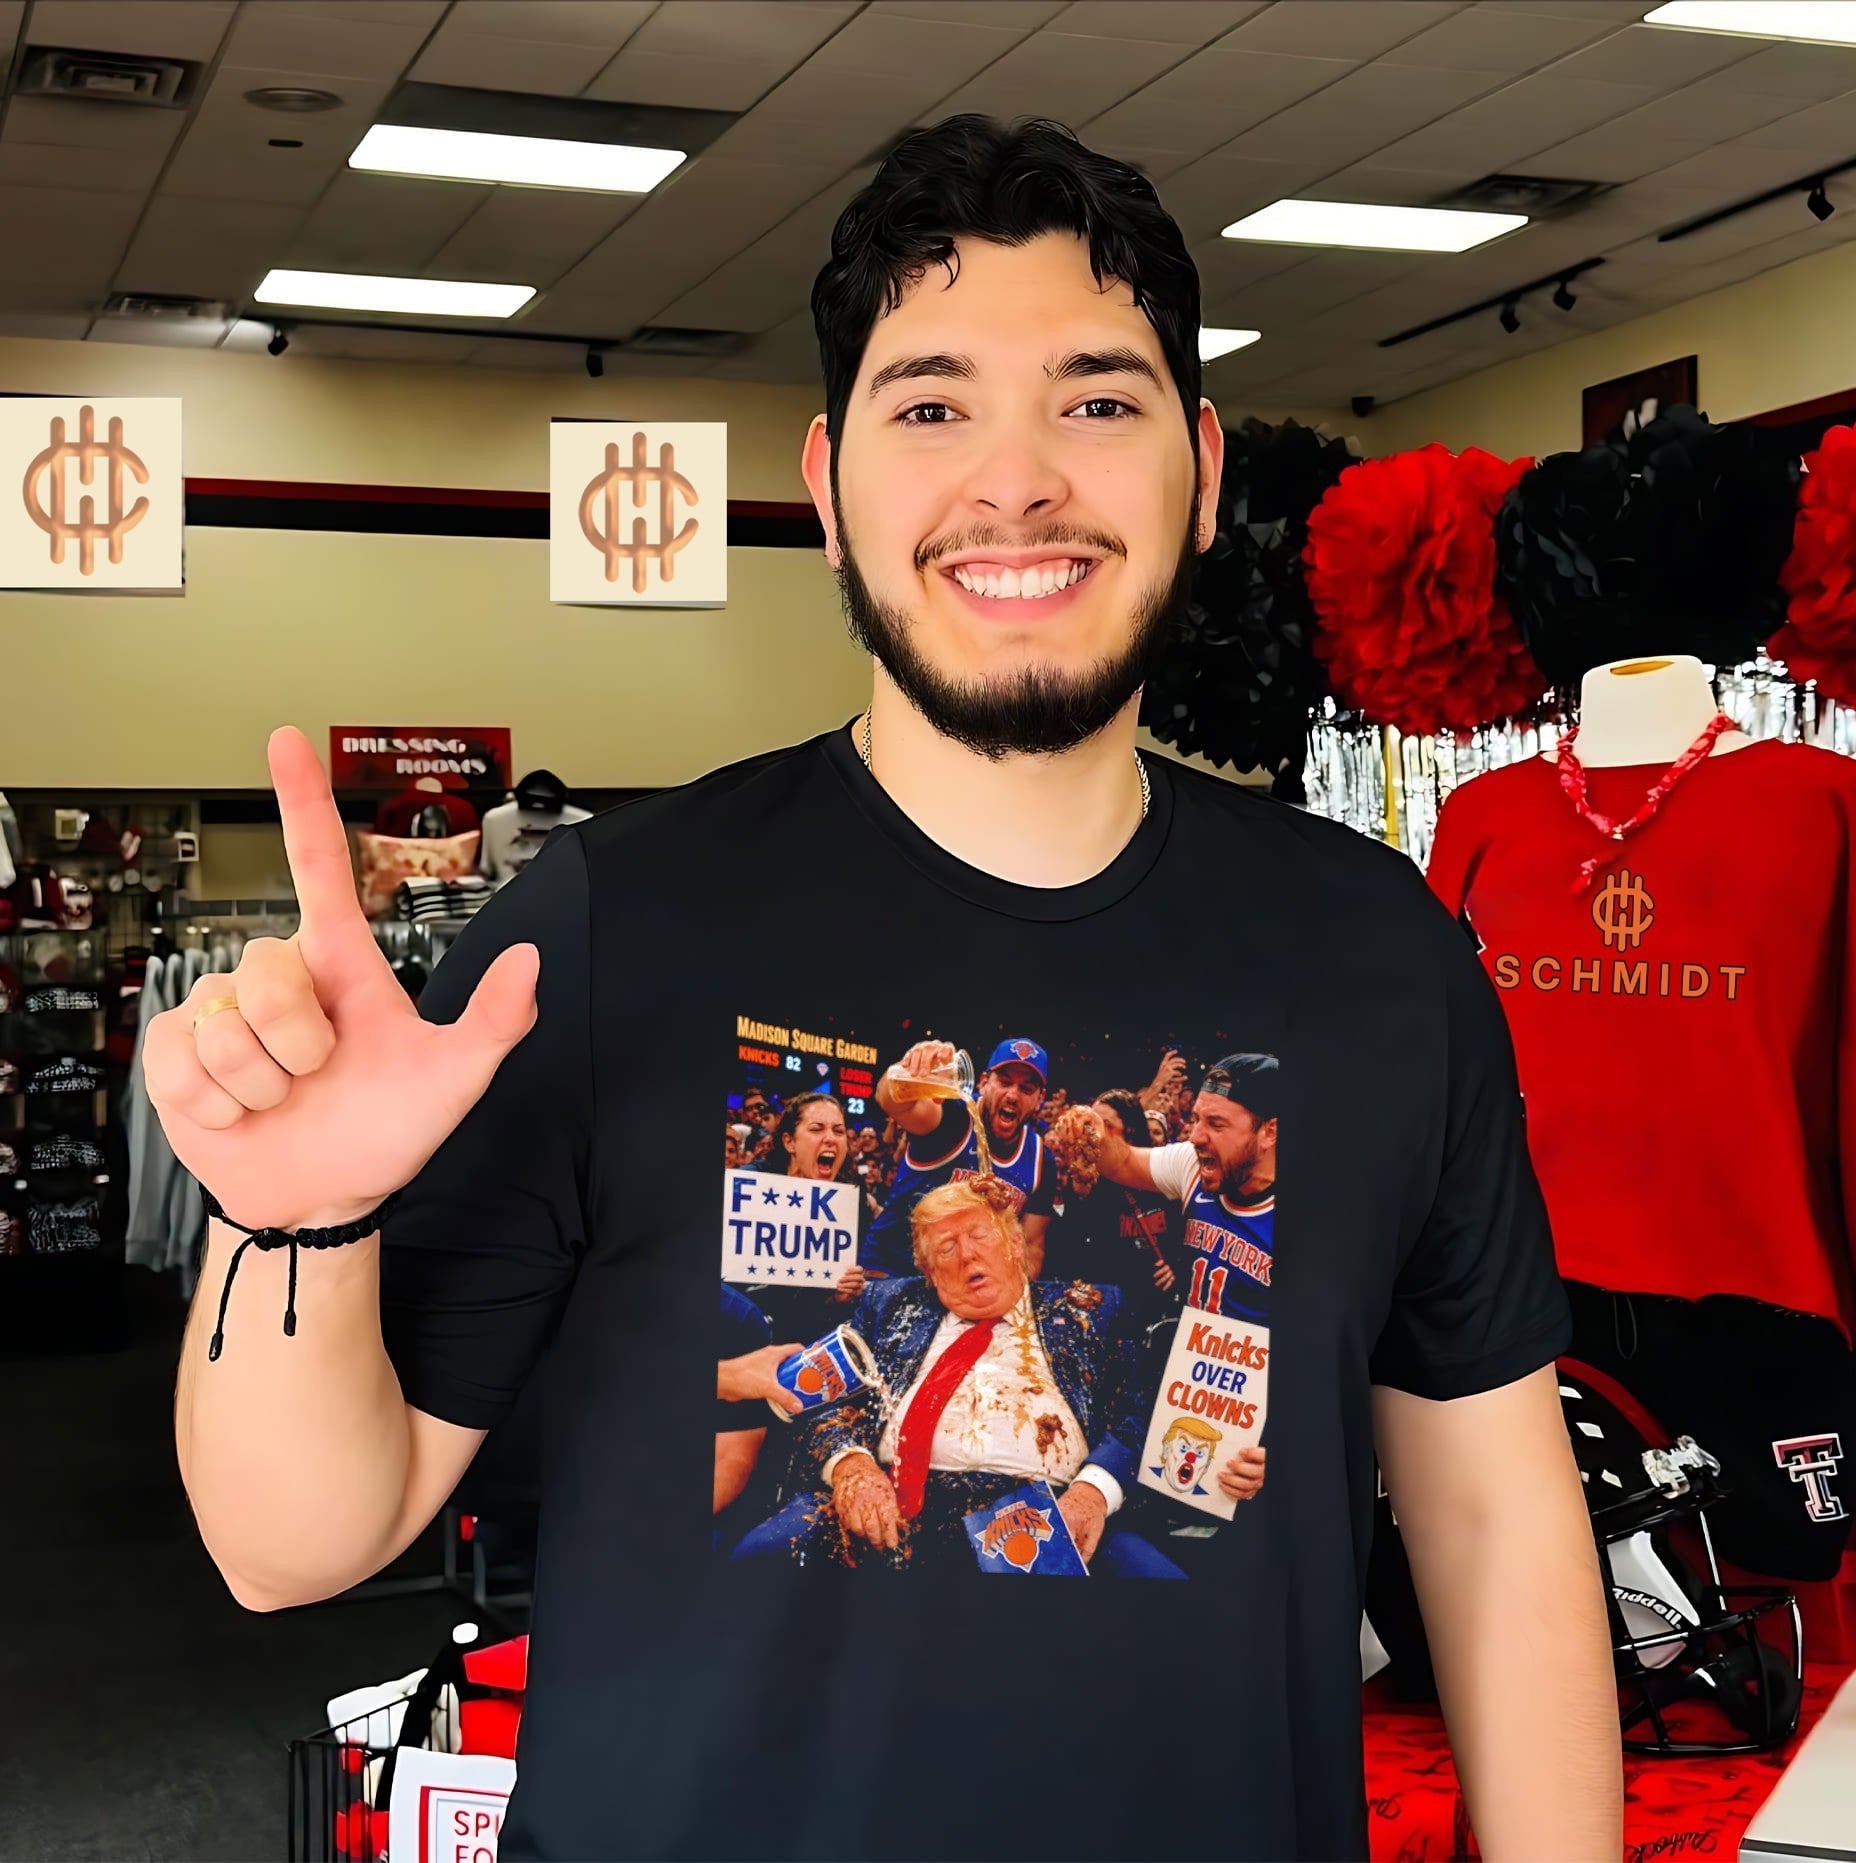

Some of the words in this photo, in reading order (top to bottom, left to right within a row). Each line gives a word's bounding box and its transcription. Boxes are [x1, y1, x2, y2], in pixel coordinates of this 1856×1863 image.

[1494, 953, 1746, 1001] SCHMIDT
[738, 1045, 781, 1068] KNICKS
[785, 1055, 802, 1073] 82
[847, 1098, 865, 1115] 23
[729, 1219, 852, 1263] TRUMP
[1184, 1218, 1220, 1254] NEW
[1218, 1229, 1273, 1287] YORK
[1187, 1257, 1230, 1315] 11
[1186, 1322, 1270, 1371] Knicks
[1191, 1361, 1248, 1395] OVER
[1166, 1381, 1258, 1430] CLOWNS
